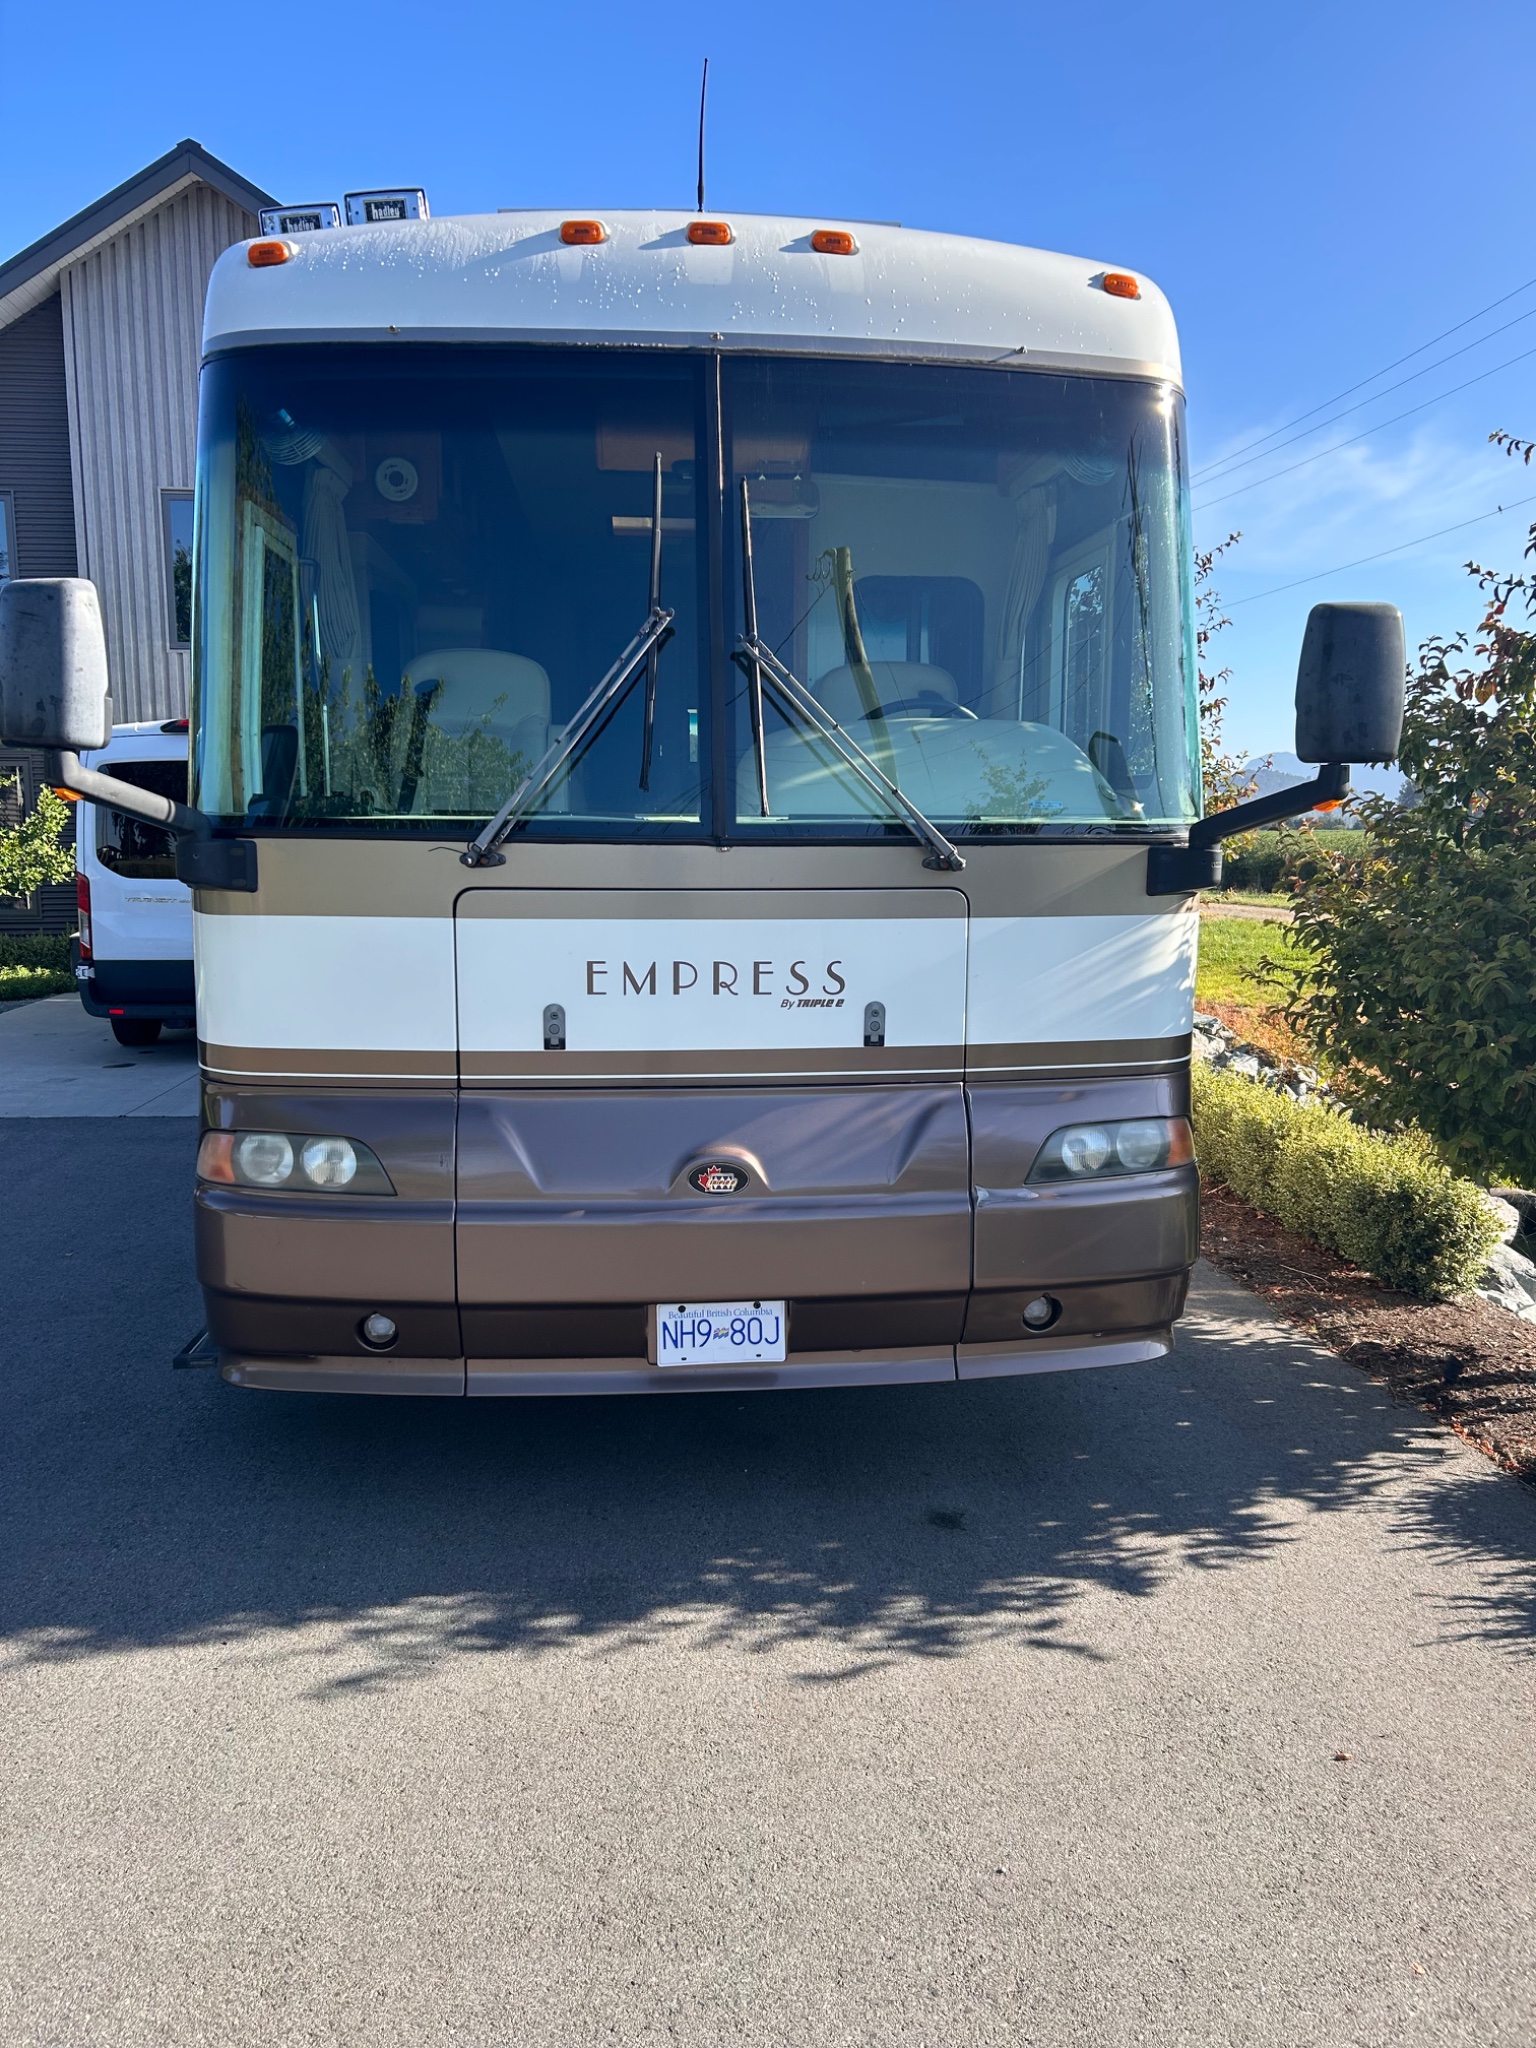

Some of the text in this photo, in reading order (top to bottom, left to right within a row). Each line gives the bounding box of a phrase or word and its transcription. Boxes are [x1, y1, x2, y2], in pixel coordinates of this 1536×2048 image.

[371, 203, 400, 220] hadley
[586, 960, 846, 996] EMPRESS
[780, 998, 795, 1011] By
[797, 998, 834, 1008] TRIPLE
[668, 1306, 773, 1319] Beautiful British Columbia
[662, 1316, 780, 1350] NH9 80J
